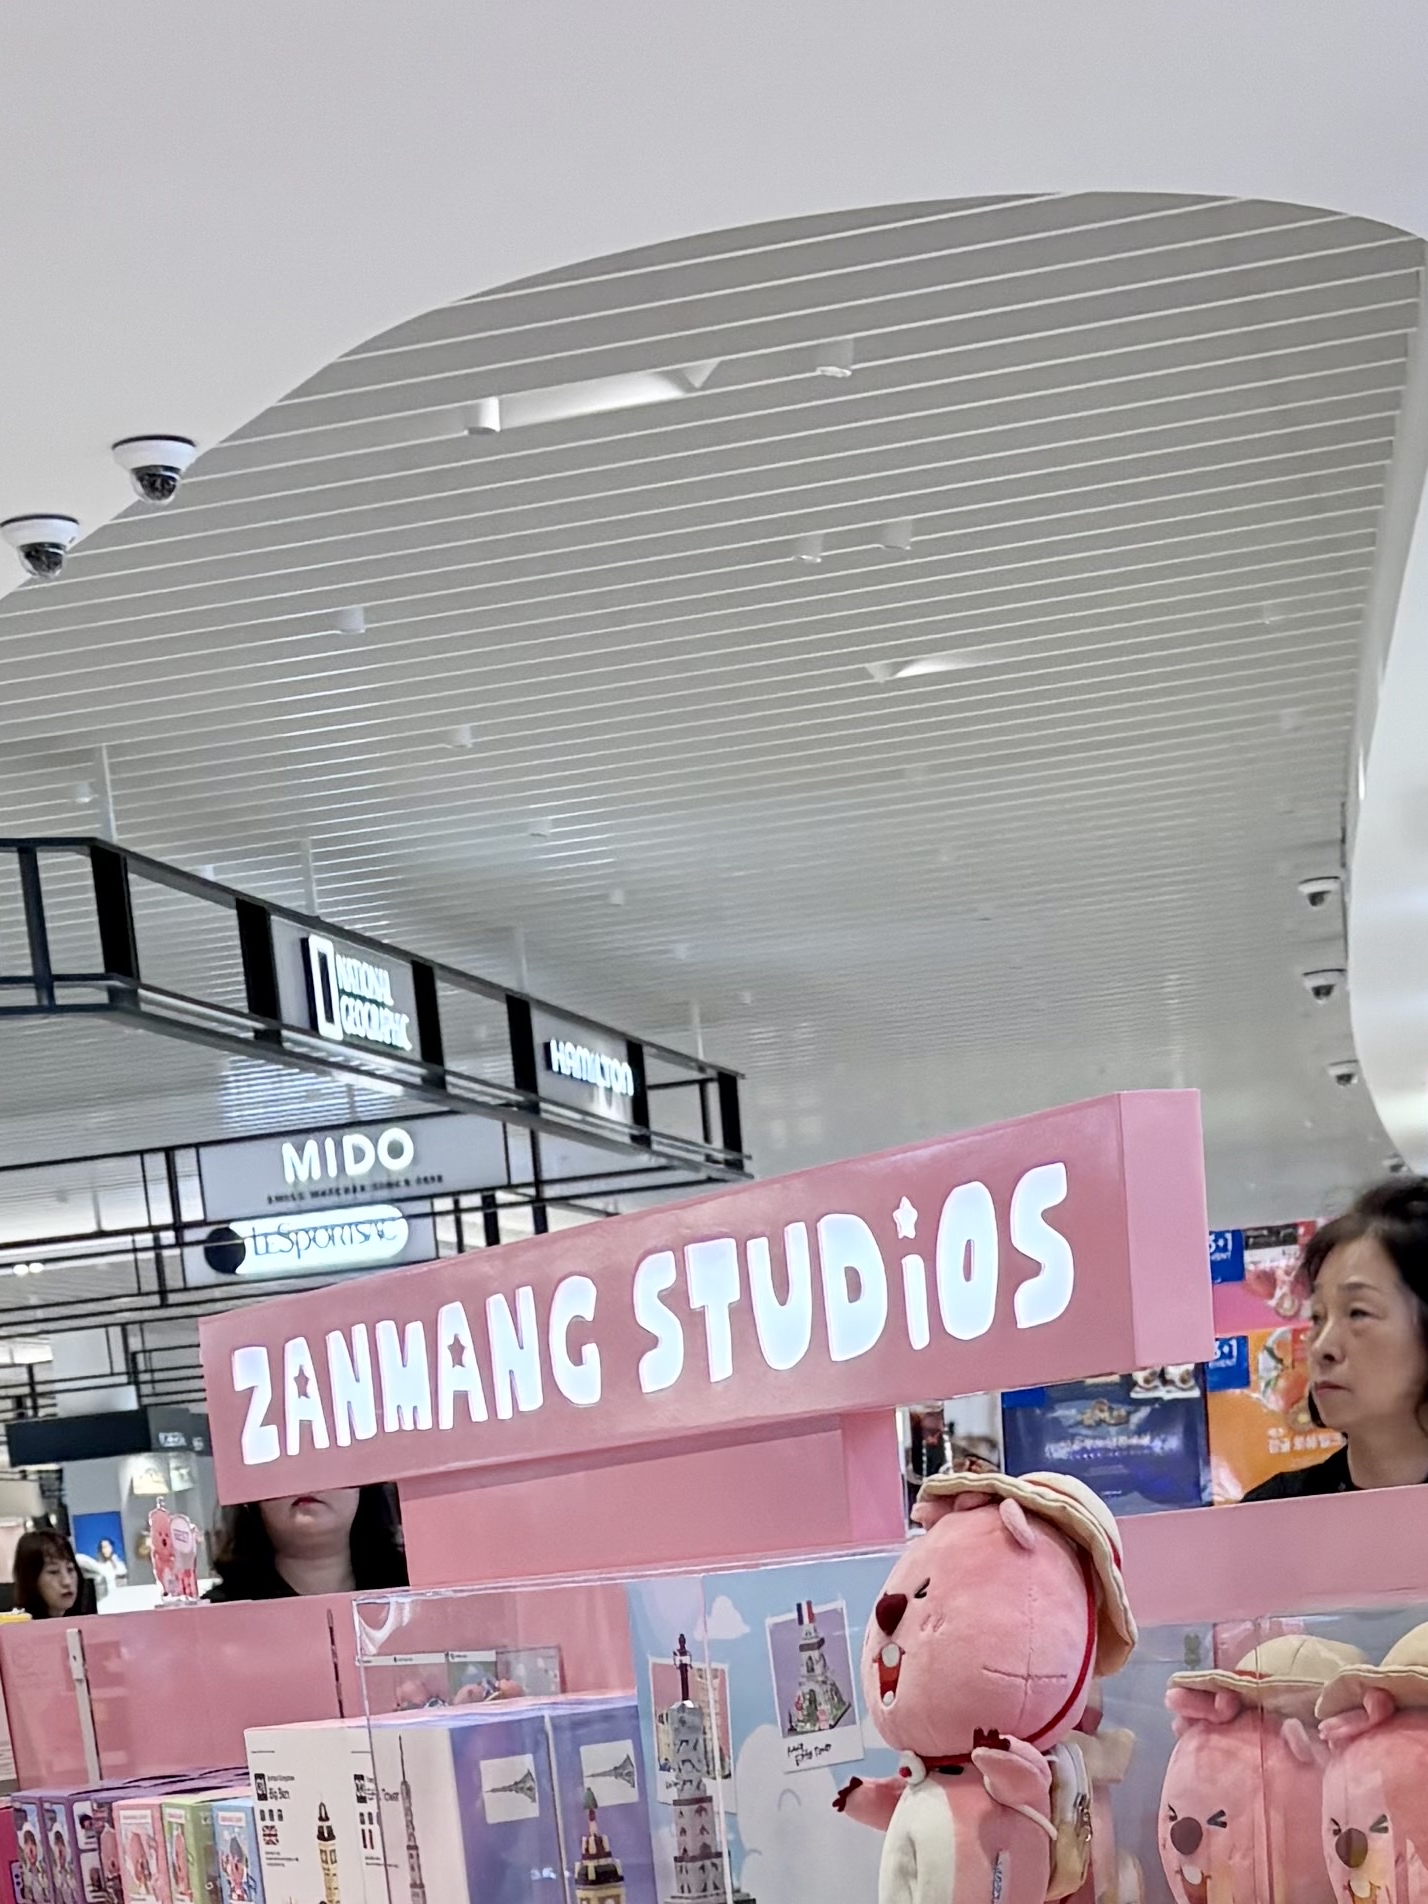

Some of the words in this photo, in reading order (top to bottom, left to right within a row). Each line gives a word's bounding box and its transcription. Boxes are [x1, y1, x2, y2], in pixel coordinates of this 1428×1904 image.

[335, 953, 395, 1007] NATIONAL
[340, 996, 412, 1052] GEOGRAPHIC
[549, 1038, 634, 1097] HAMILTON
[281, 1128, 414, 1184] MIDO
[232, 1275, 602, 1465] ZANMANG
